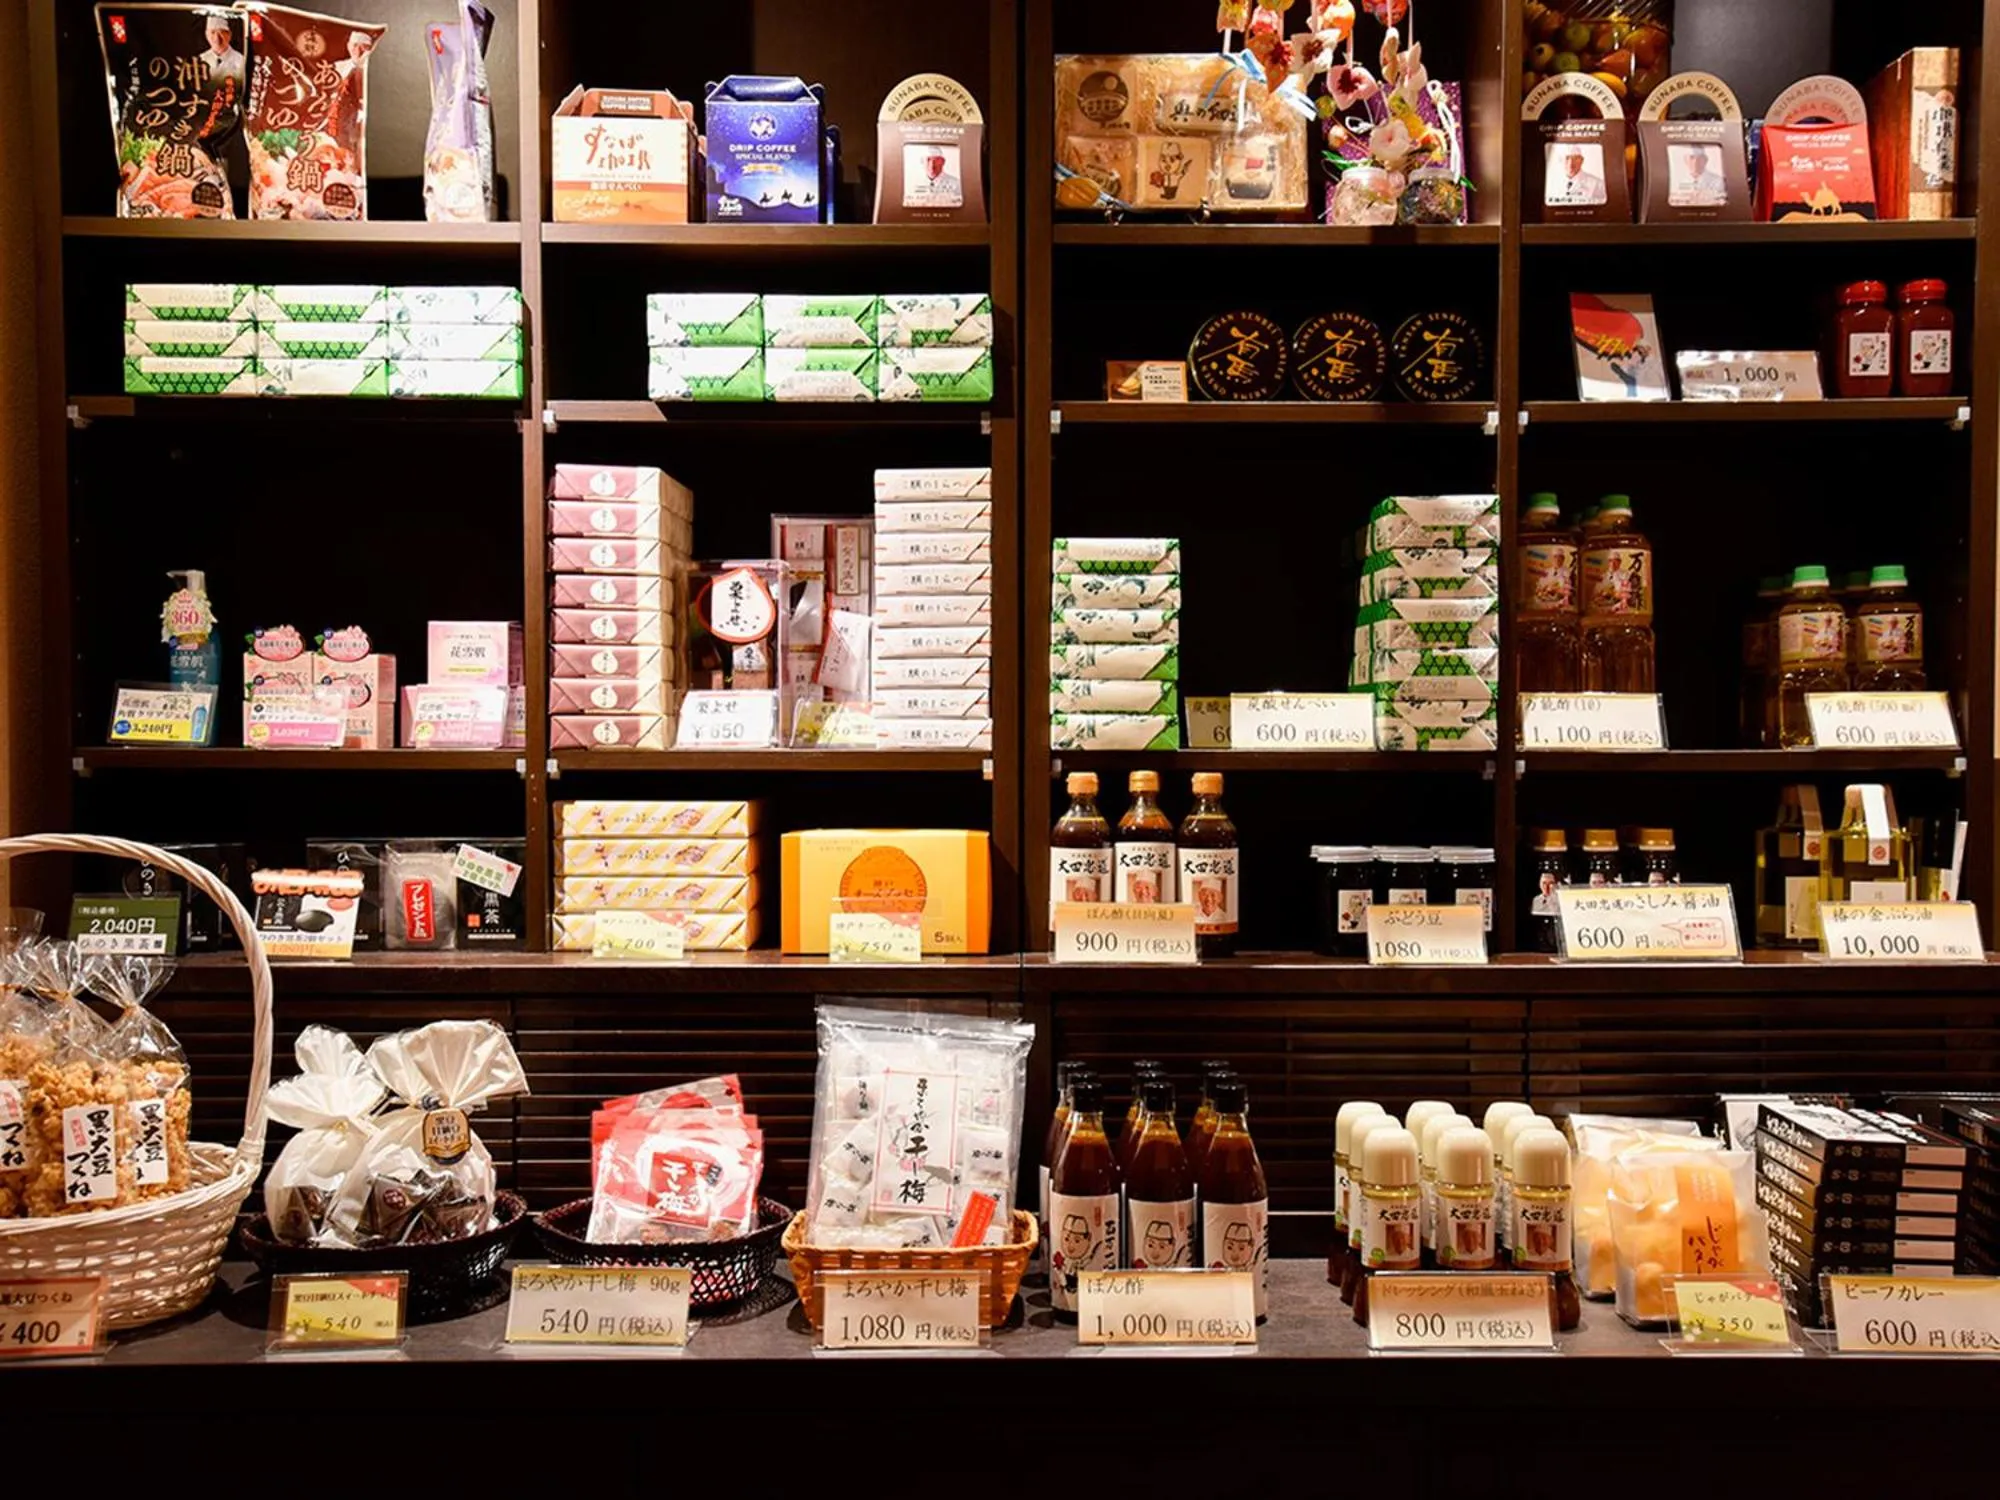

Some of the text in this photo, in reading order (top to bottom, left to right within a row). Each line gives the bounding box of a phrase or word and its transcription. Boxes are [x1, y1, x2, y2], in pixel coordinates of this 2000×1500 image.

[135, 57, 178, 128] のつゆ
[887, 80, 975, 116] SUNABA COFFEE
[1527, 79, 1615, 112] SUNABA COFFEE
[1649, 79, 1735, 114] SUNABA COFFEE
[154, 56, 211, 178] 沖すき鍋
[729, 144, 797, 153] DRIP COFFEE
[1202, 313, 1234, 346] TANSAN
[1724, 366, 1780, 383] 1,000
[170, 609, 199, 626] 360
[1247, 697, 1336, 712] 炭酸せんべい
[1256, 723, 1367, 743] 600 円(税込)
[1533, 727, 1661, 745] 1,100 円(税込)
[1835, 726, 1947, 744] 600 円(税込)
[90, 918, 156, 935] 2,040円
[1384, 909, 1442, 926] ぶどう豆
[1075, 931, 1191, 954] 900 円(税込)
[1577, 926, 1625, 949] 600
[1843, 935, 1920, 957] 10,000
[1375, 941, 1422, 958] 1080
[86, 1109, 114, 1177] 黒大豆
[139, 1102, 165, 1162] 黒大豆
[0, 1121, 26, 1167] つくね
[66, 1151, 93, 1198] つくね
[515, 1273, 681, 1293] まろやか干し梅 90g
[841, 1278, 968, 1299] まろやか干し梅
[1844, 1283, 1945, 1302] ビーフカレー
[11, 1319, 61, 1345] 400
[322, 1315, 362, 1333] 540
[540, 1308, 674, 1337] 540 円(税込)
[840, 1314, 977, 1343] 1,080 円(税込)
[1094, 1314, 1252, 1340] 1,000 円(税込)
[1396, 1312, 1535, 1339] 800 円(税込)
[1717, 1317, 1755, 1332] 350
[1865, 1319, 1918, 1346] 600
